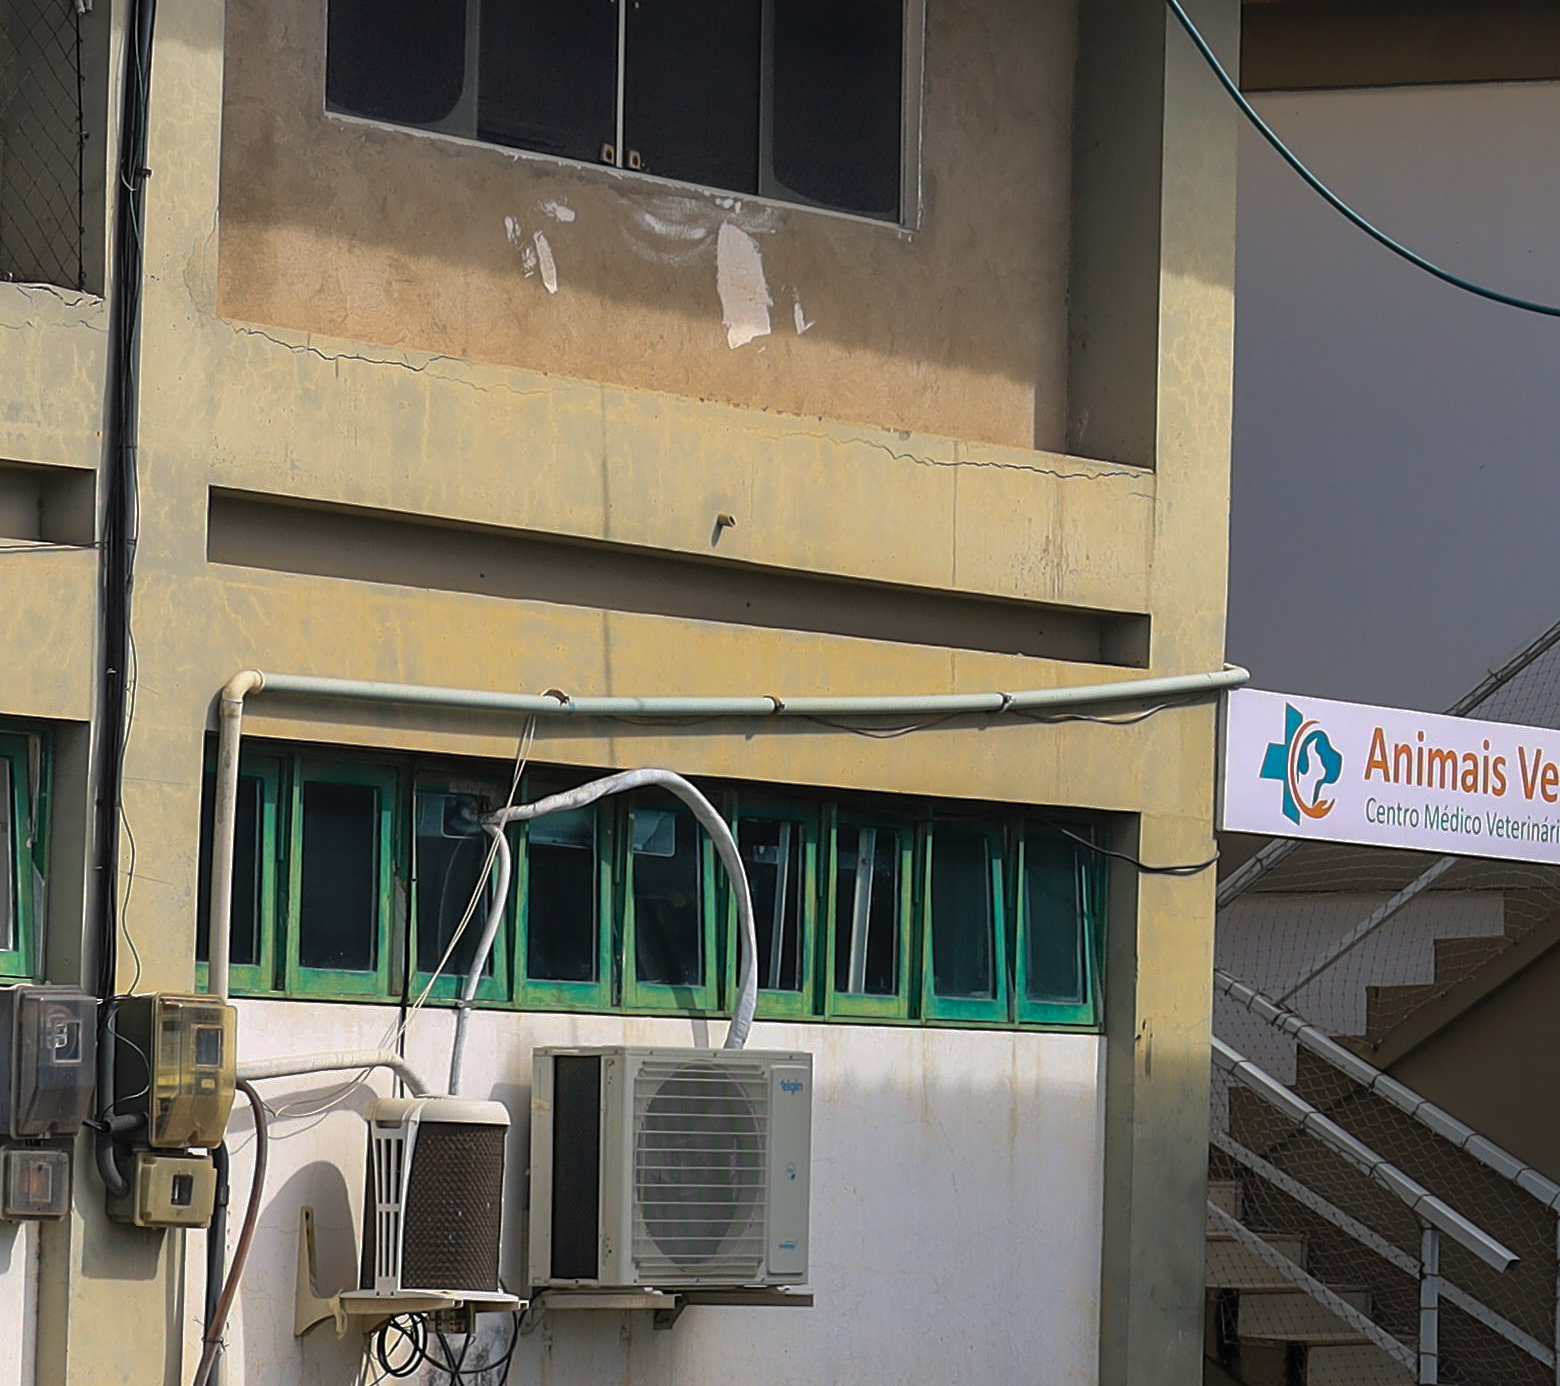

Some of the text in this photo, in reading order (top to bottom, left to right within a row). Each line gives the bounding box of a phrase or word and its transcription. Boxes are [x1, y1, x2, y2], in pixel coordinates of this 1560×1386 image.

[1364, 727, 1507, 798] Animais
[1365, 797, 1419, 829] Centro
[1424, 803, 1482, 837] Médico
